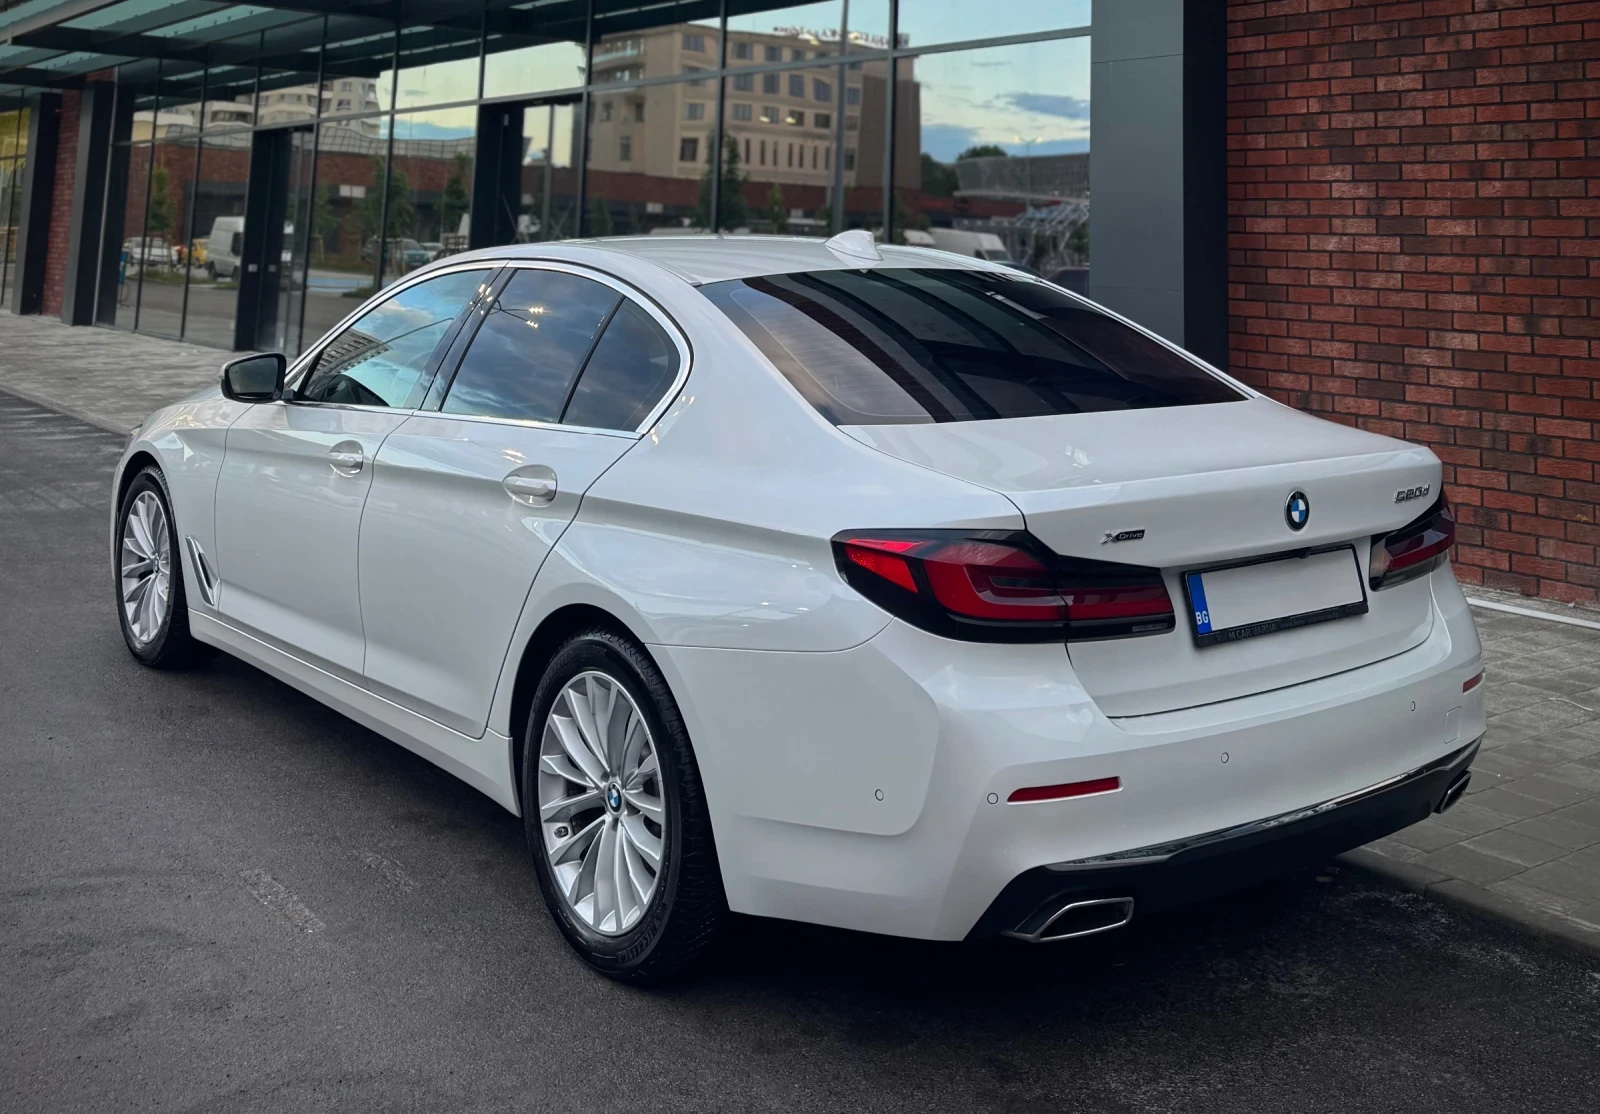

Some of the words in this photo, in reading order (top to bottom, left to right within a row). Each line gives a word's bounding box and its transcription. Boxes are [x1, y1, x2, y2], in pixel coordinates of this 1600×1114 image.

[1393, 484, 1430, 503] 520d
[1195, 611, 1209, 626] BG
[1228, 631, 1236, 641] M
[1236, 628, 1252, 639] CAR
[1252, 623, 1277, 636] VARNA
